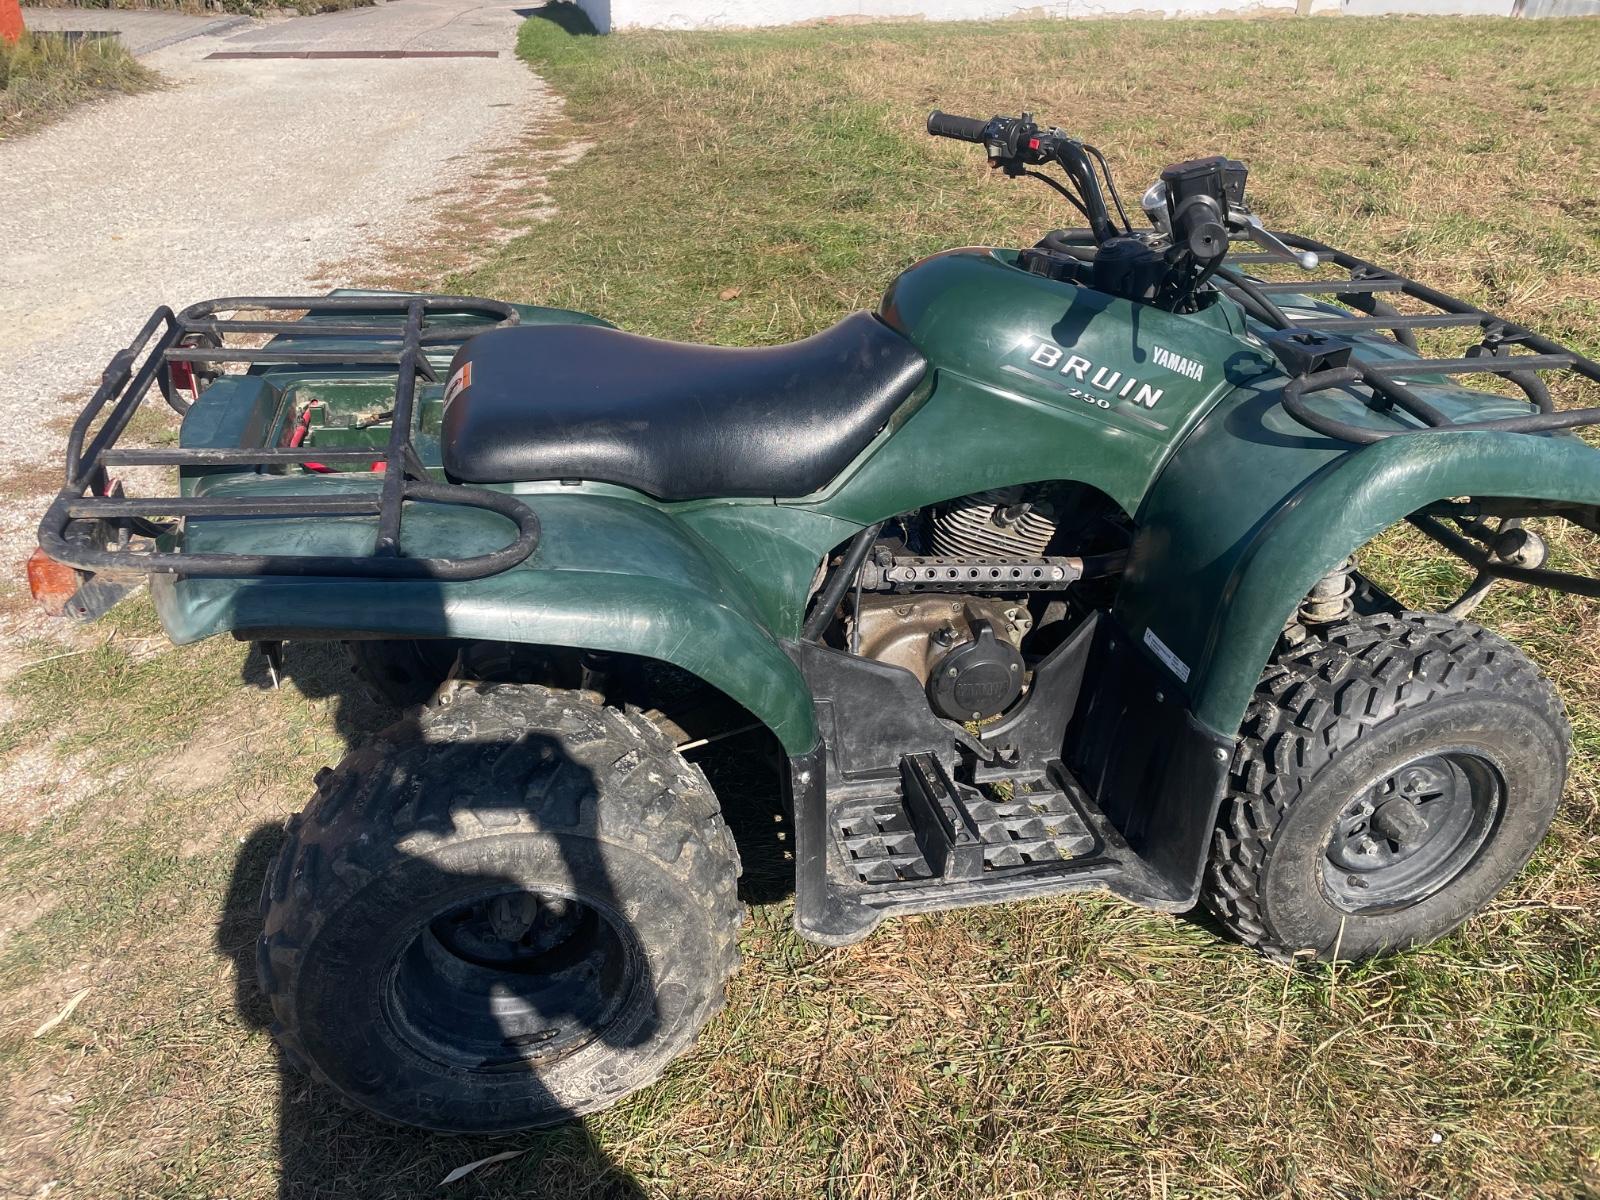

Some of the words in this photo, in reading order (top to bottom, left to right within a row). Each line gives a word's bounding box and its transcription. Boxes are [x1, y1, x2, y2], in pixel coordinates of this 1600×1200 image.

[1029, 342, 1165, 410] BRUIN
[1152, 346, 1204, 382] YAMAHA
[1068, 388, 1111, 410] 250
